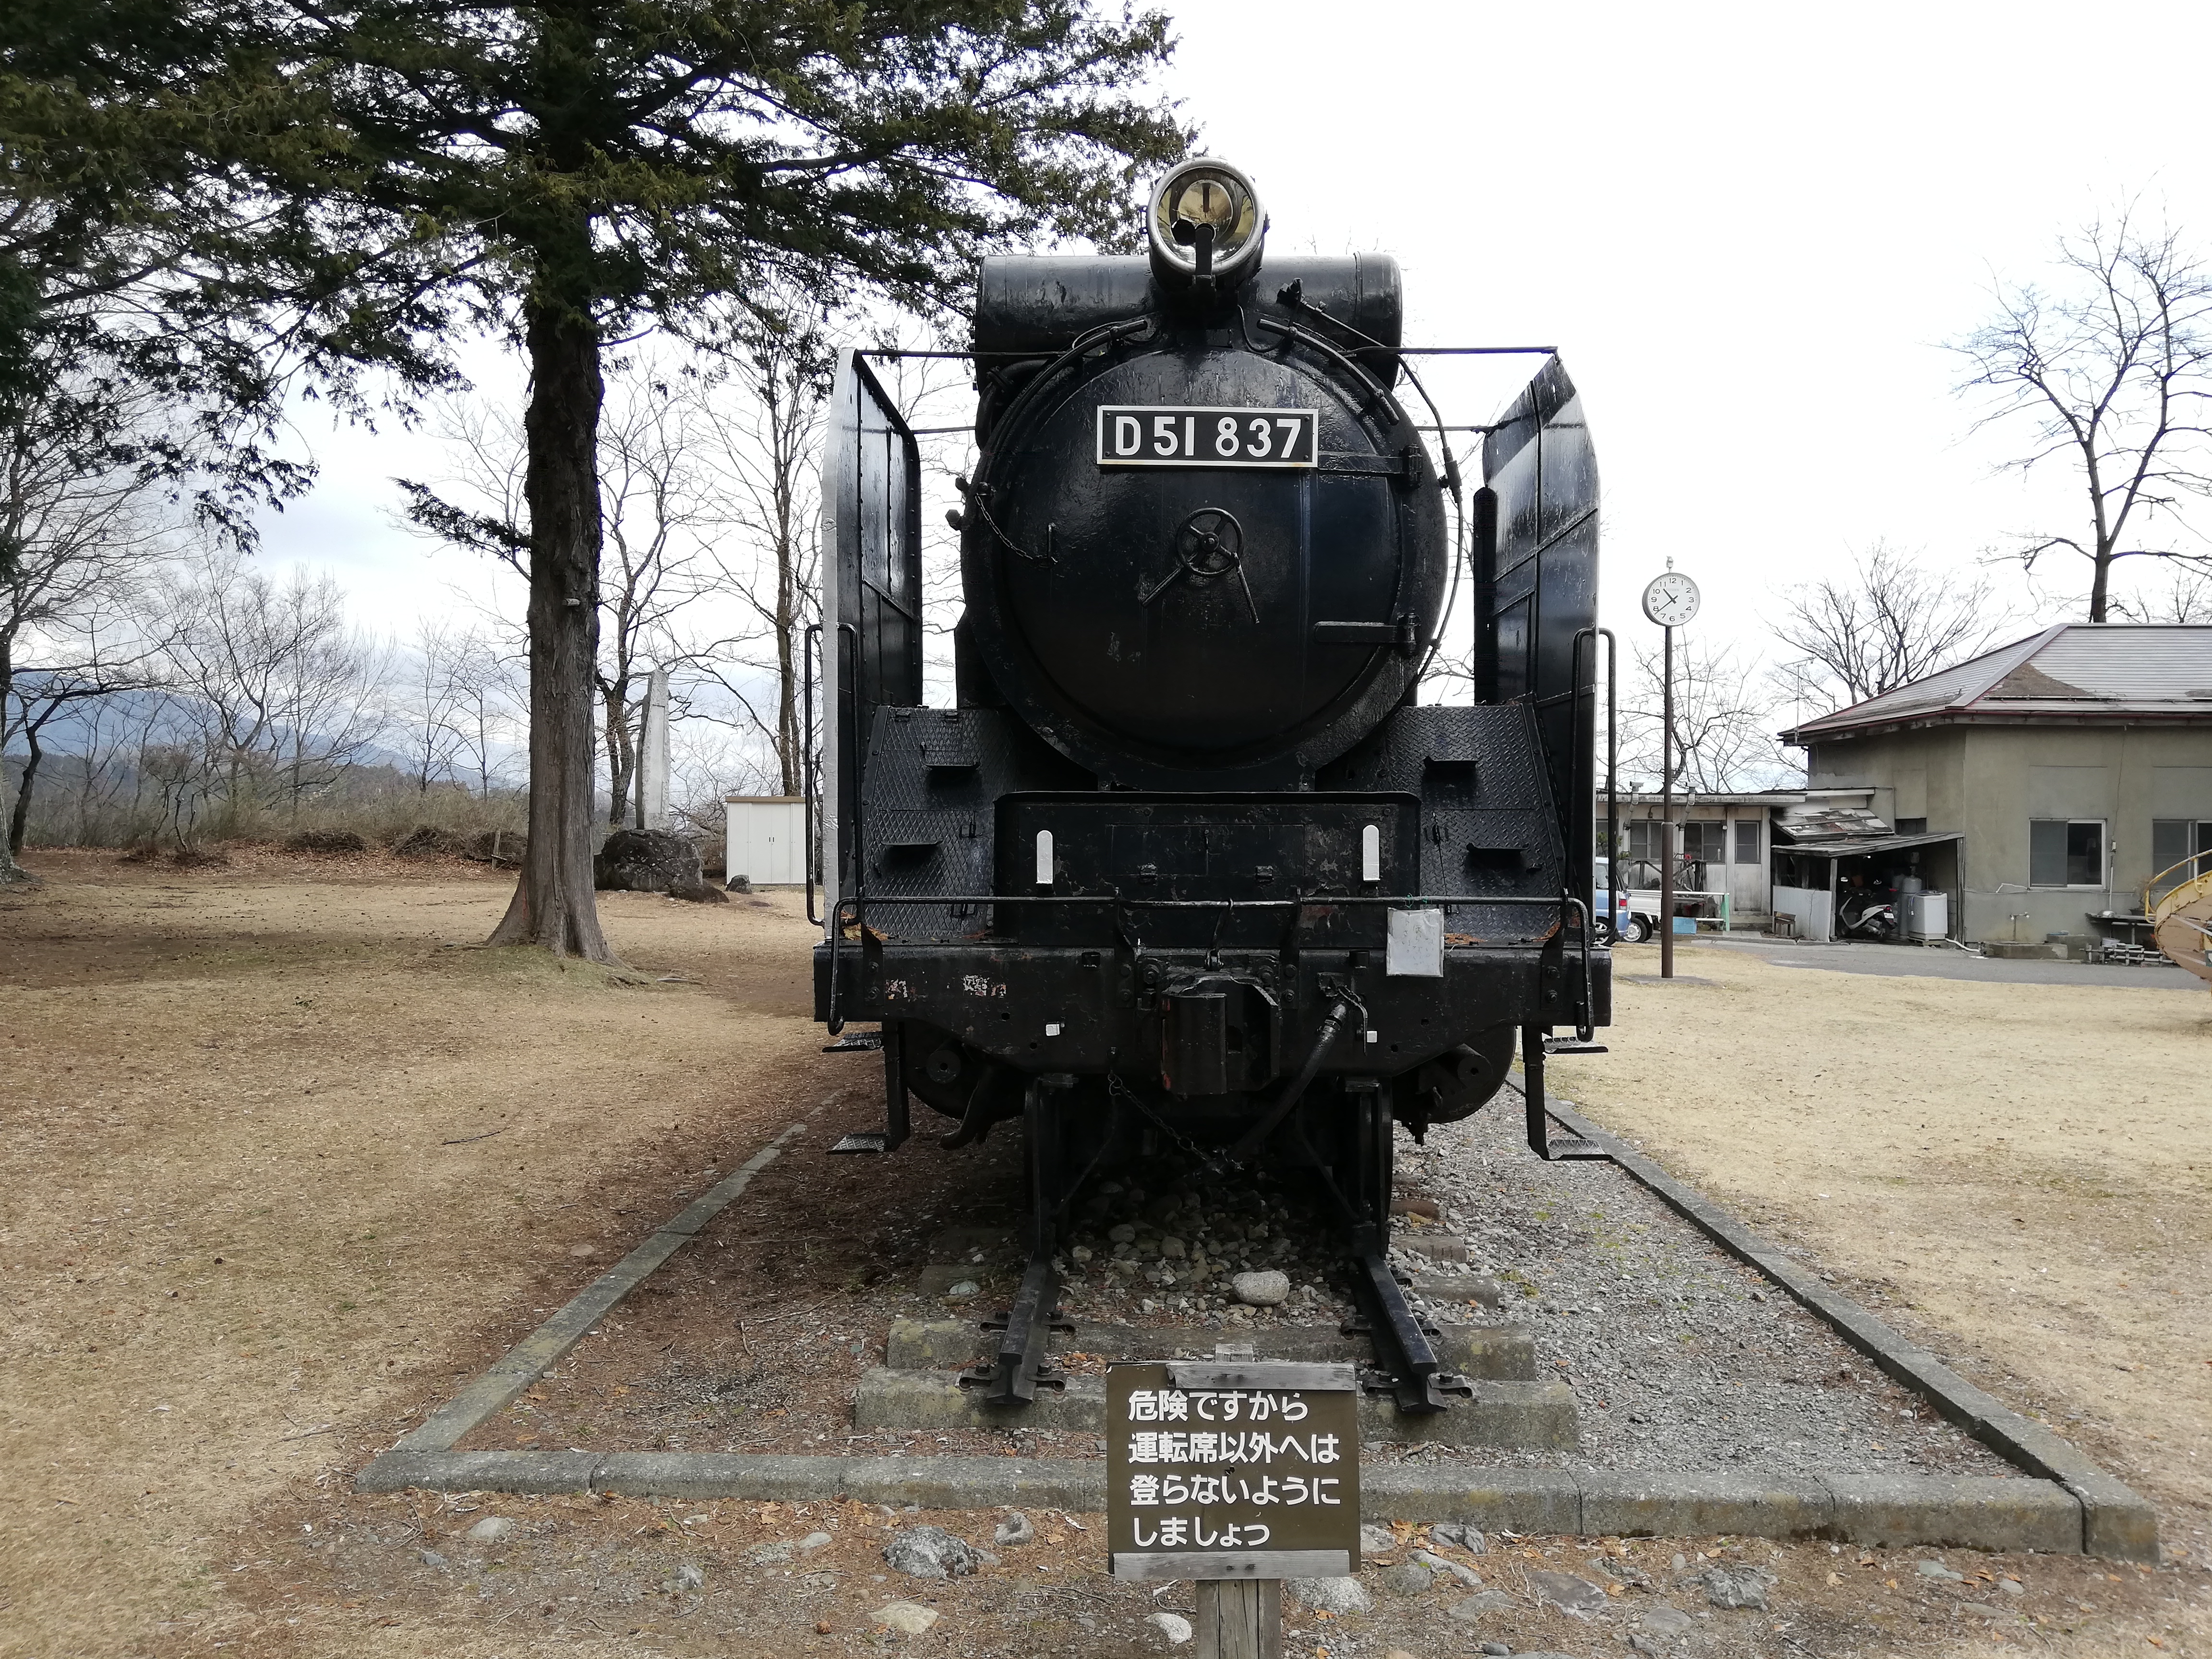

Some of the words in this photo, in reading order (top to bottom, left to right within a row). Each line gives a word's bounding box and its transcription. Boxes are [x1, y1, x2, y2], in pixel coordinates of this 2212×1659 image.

[1115, 416, 1142, 456] D
[1154, 416, 1195, 457] 51
[1215, 416, 1301, 458] 837
[1128, 1390, 1309, 1422] 危険ですから
[1128, 1431, 1340, 1464] 運転席以外へは
[1130, 1474, 1341, 1506] 登らないように
